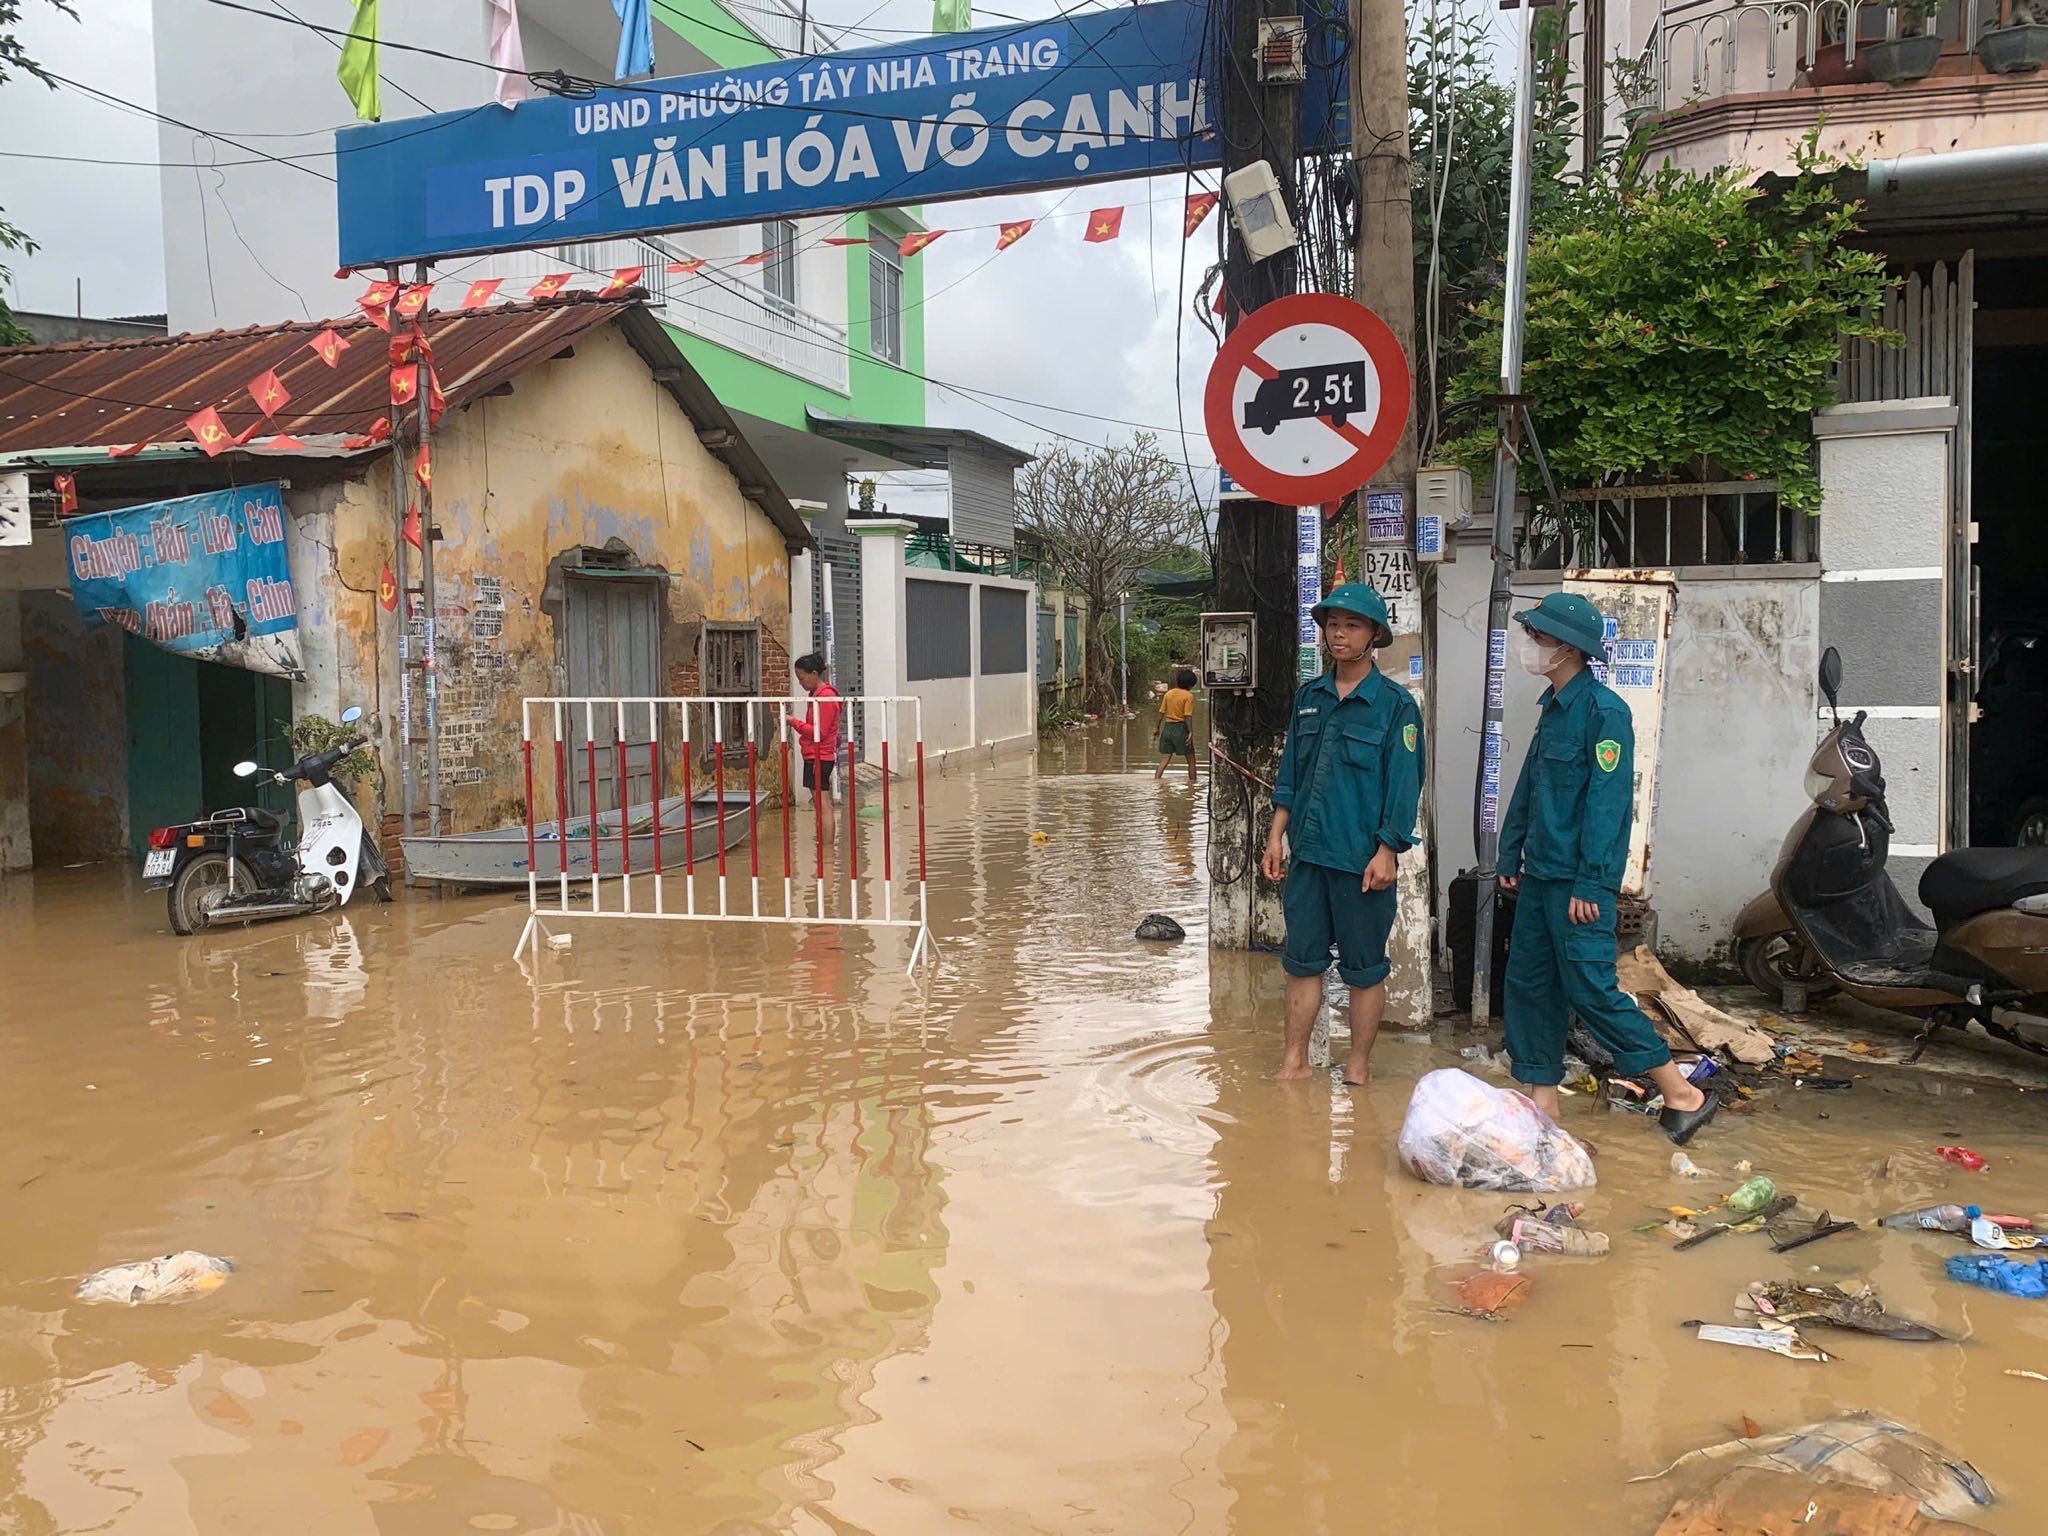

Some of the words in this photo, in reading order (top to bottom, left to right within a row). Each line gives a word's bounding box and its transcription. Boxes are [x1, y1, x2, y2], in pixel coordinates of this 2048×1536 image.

[574, 98, 650, 135] UBND
[660, 75, 789, 123] PHƯỜNG
[799, 61, 856, 103] TÂY
[866, 52, 937, 95] NHA
[946, 38, 1060, 82] TRANG
[484, 169, 586, 228] TDP
[611, 135, 727, 208] VĂN
[743, 114, 881, 194] HÓA
[891, 92, 989, 173] VÕ
[1006, 77, 1211, 171] CẠNH
[1292, 373, 1353, 412] 2,5t
[198, 507, 237, 555] Lúa
[244, 499, 284, 545] Cám
[1366, 552, 1411, 573] B-74A
[246, 576, 296, 622] Chim
